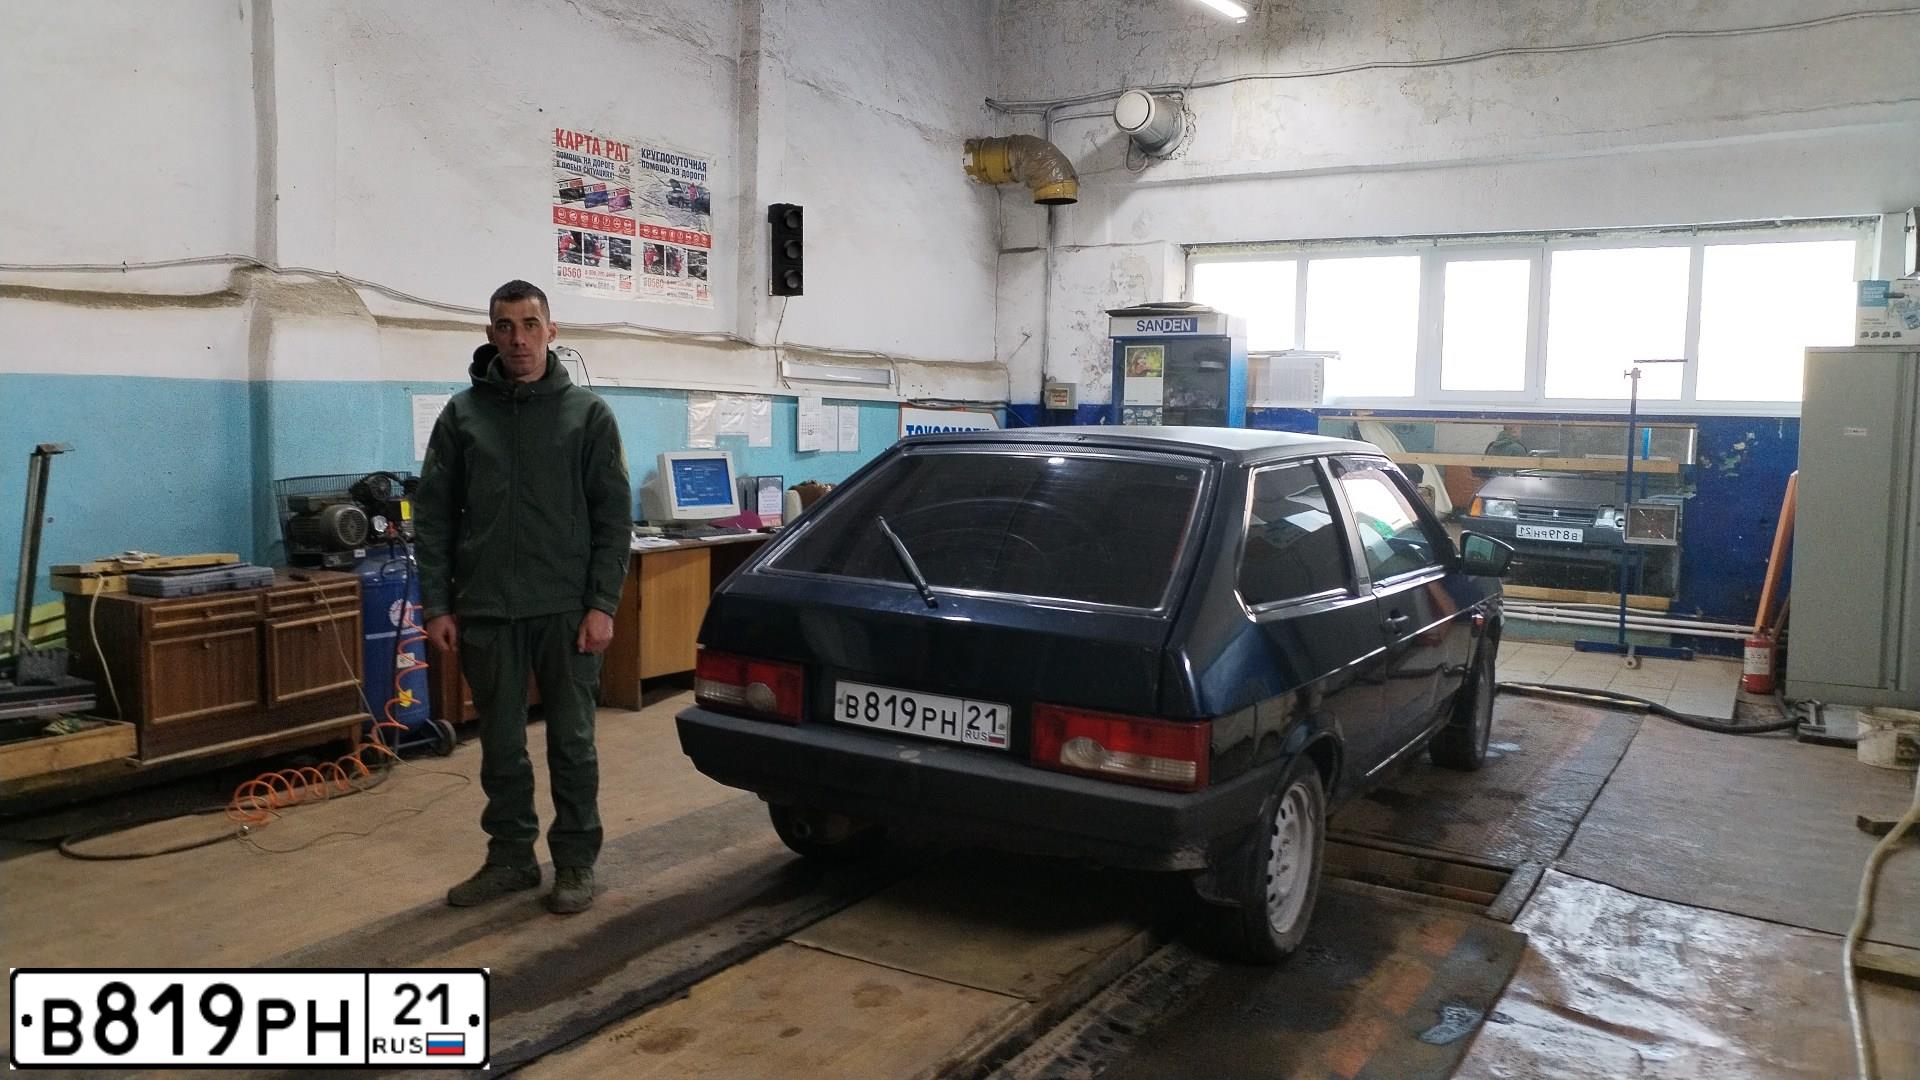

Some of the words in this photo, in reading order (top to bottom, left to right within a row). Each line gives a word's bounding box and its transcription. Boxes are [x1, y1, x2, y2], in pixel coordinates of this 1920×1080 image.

[556, 127, 601, 156] КАРТА
[606, 139, 630, 162] РАТ
[556, 150, 582, 164] ПОМОЩЬ
[583, 156, 592, 166] НА
[592, 159, 615, 171] ДОРОГЕ
[561, 161, 582, 172] ЛЮБЫХ
[641, 147, 707, 173] КРУГЛОСУТОЧНАЯ
[671, 167, 680, 176] на
[1136, 319, 1192, 332] SANDEN
[845, 691, 957, 737] В819РН
[966, 705, 998, 733] 21
[965, 729, 988, 742] RUS
